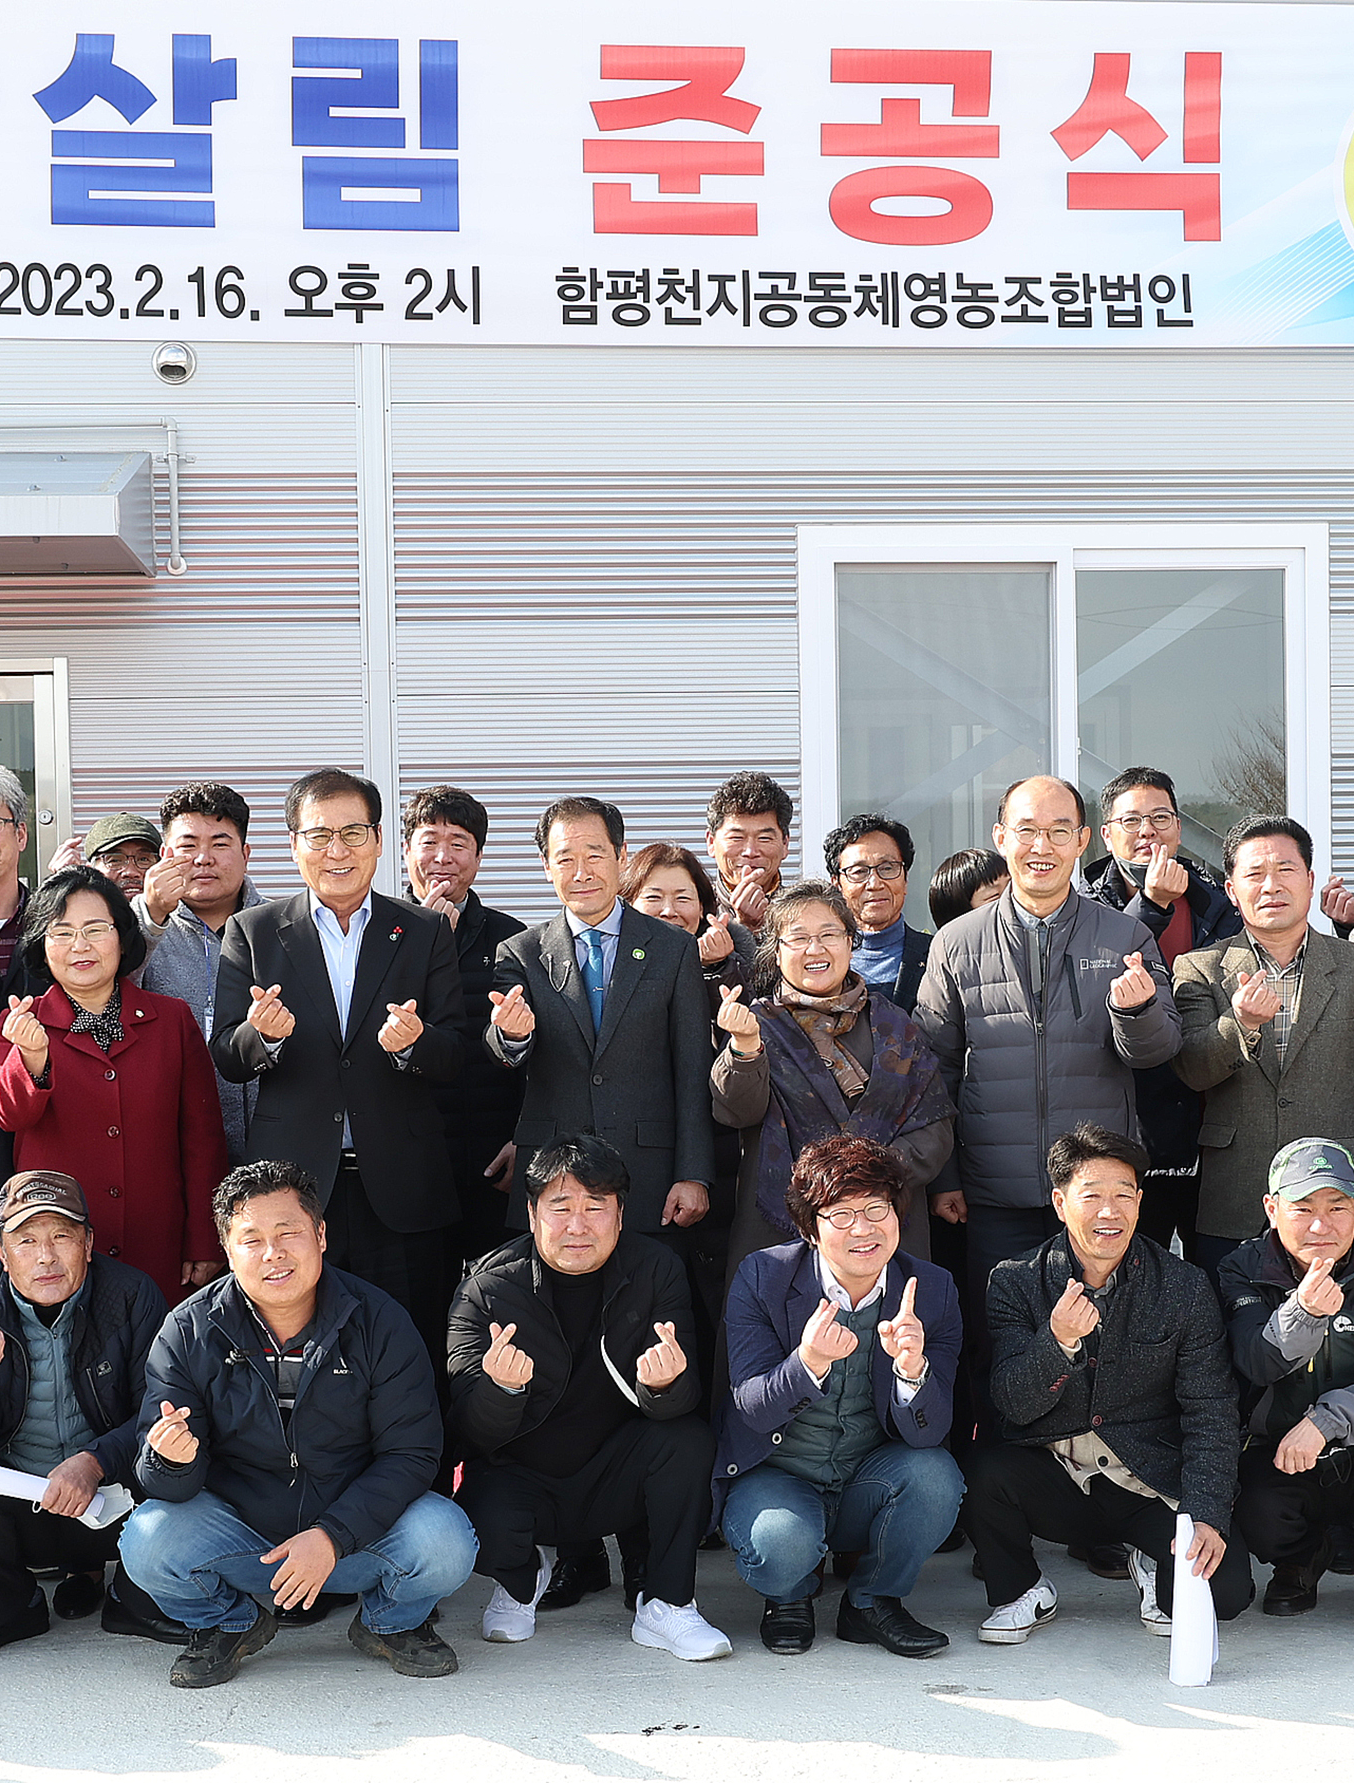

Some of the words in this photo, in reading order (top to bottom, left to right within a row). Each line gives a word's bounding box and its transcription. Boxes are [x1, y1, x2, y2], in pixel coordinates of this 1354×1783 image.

[582, 44, 1223, 247] 준공식
[283, 263, 384, 323] 오후
[404, 265, 482, 325] 2시
[554, 266, 1194, 329] 함평천지공동체영농조합법인
